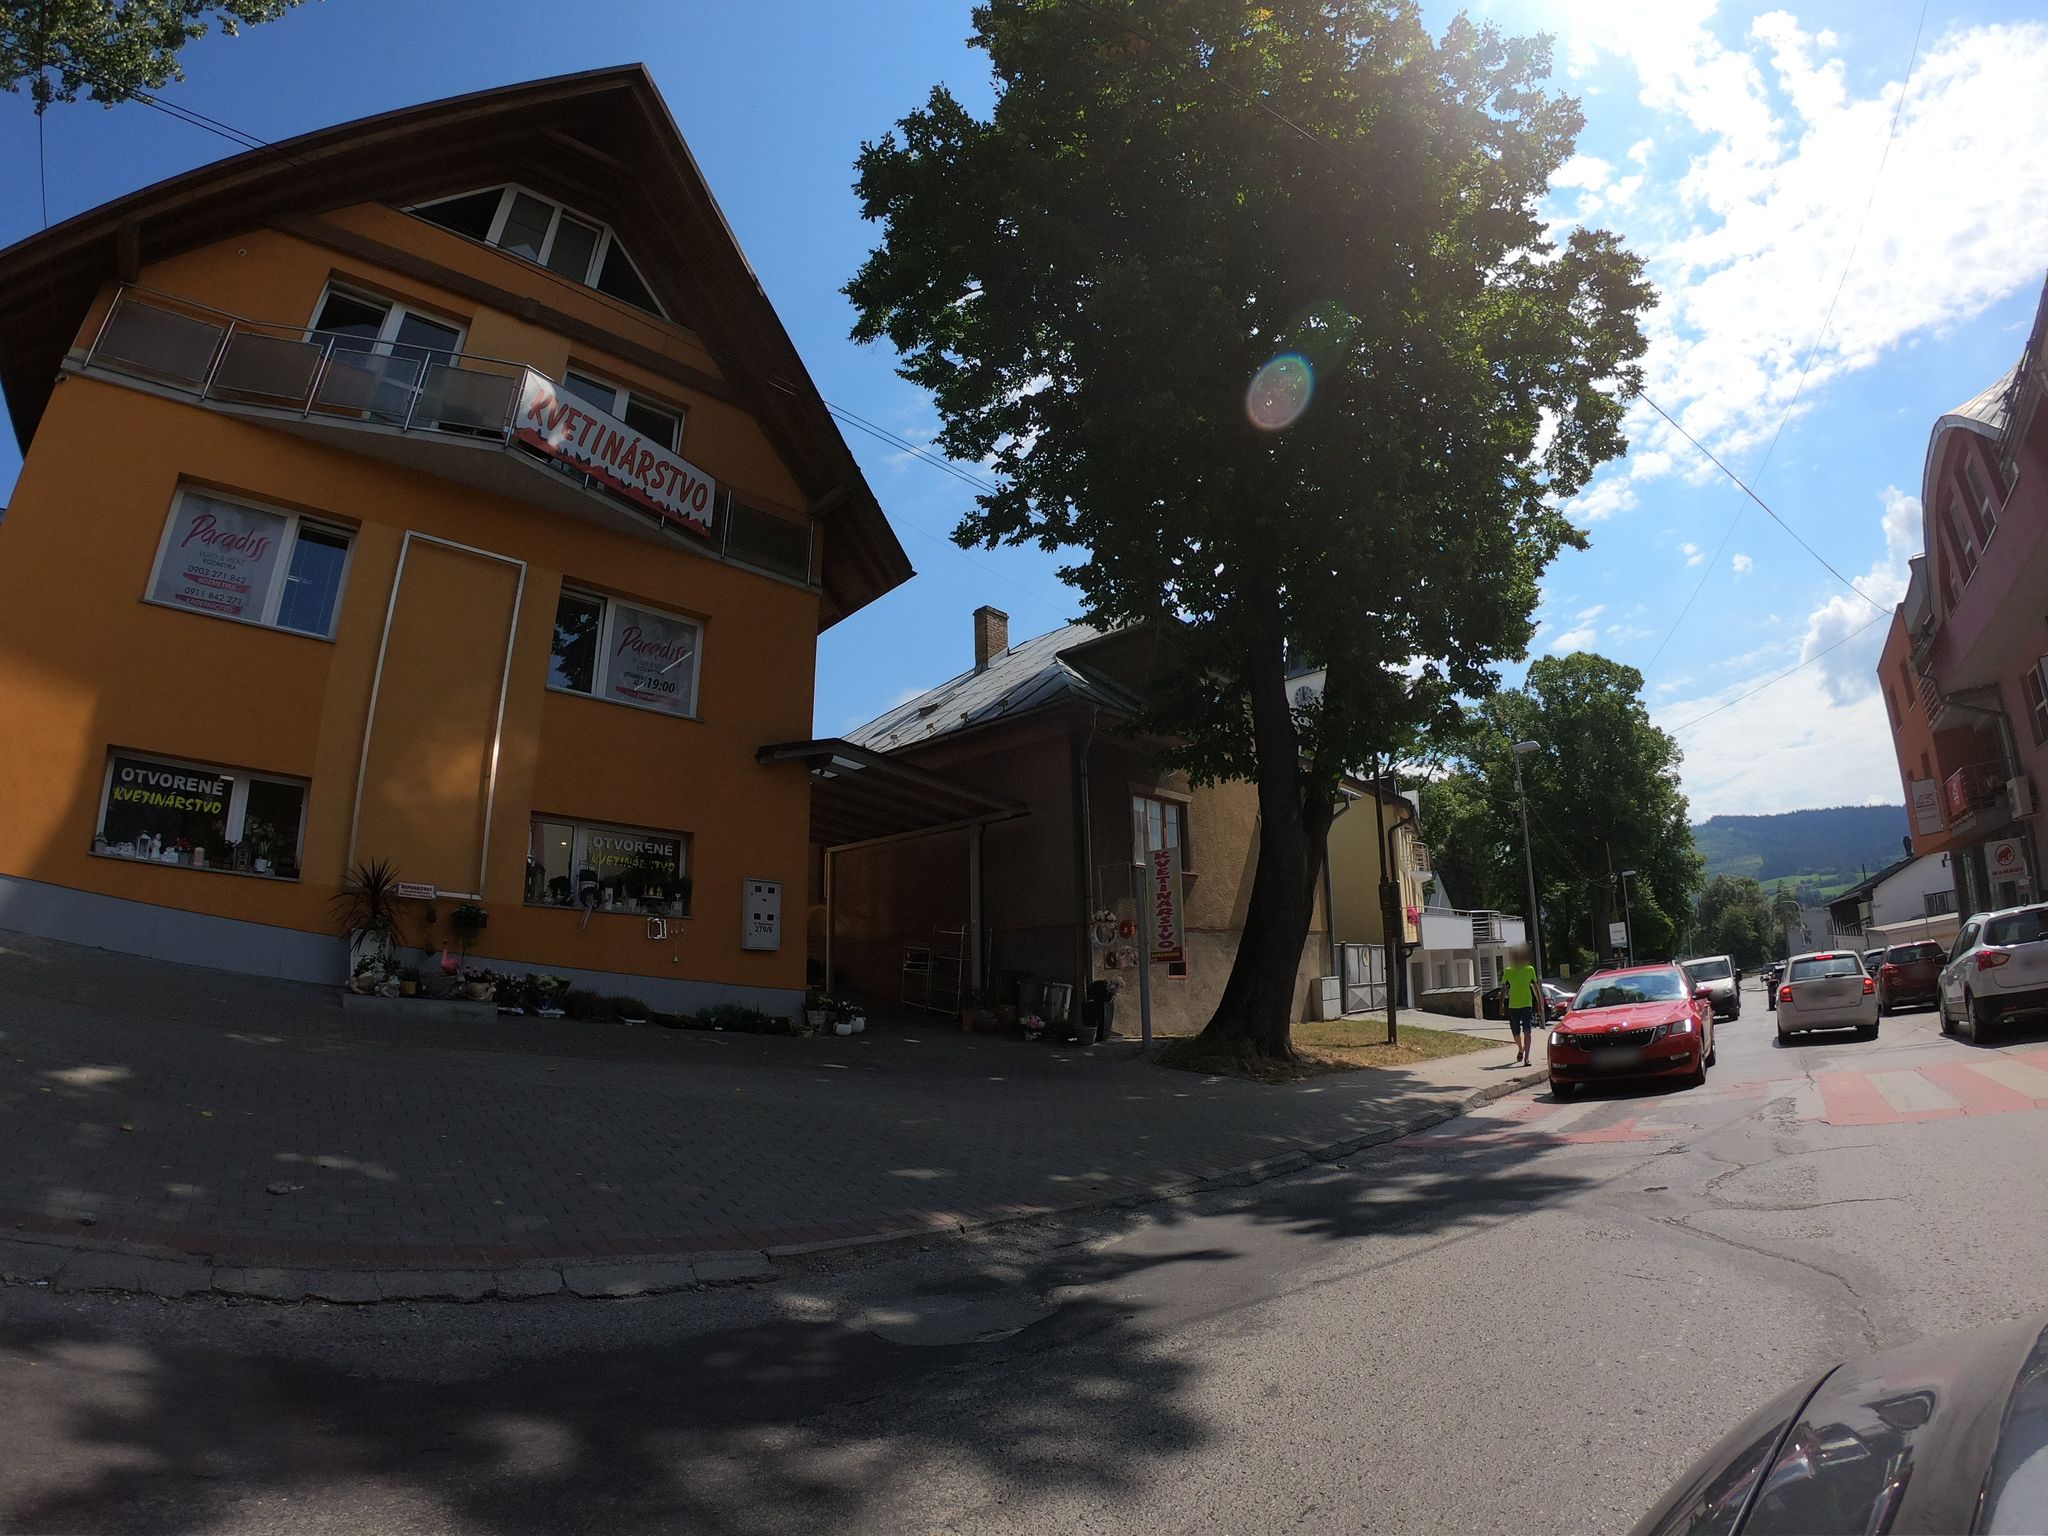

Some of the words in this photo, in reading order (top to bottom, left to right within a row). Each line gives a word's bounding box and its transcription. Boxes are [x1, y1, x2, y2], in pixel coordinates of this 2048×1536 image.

[527, 388, 709, 512] KVETINÁRSTVO
[188, 564, 210, 576] 0903
[212, 570, 227, 580] 271
[230, 574, 247, 585] 842
[184, 586, 205, 599] 0911
[208, 591, 225, 603] 842
[227, 596, 242, 606] 271
[647, 677, 676, 694] 19:00
[121, 766, 225, 797] OTVORENÉ
[113, 785, 222, 815] KVETINÁRSTVO
[593, 836, 673, 857] OTVORENÉ
